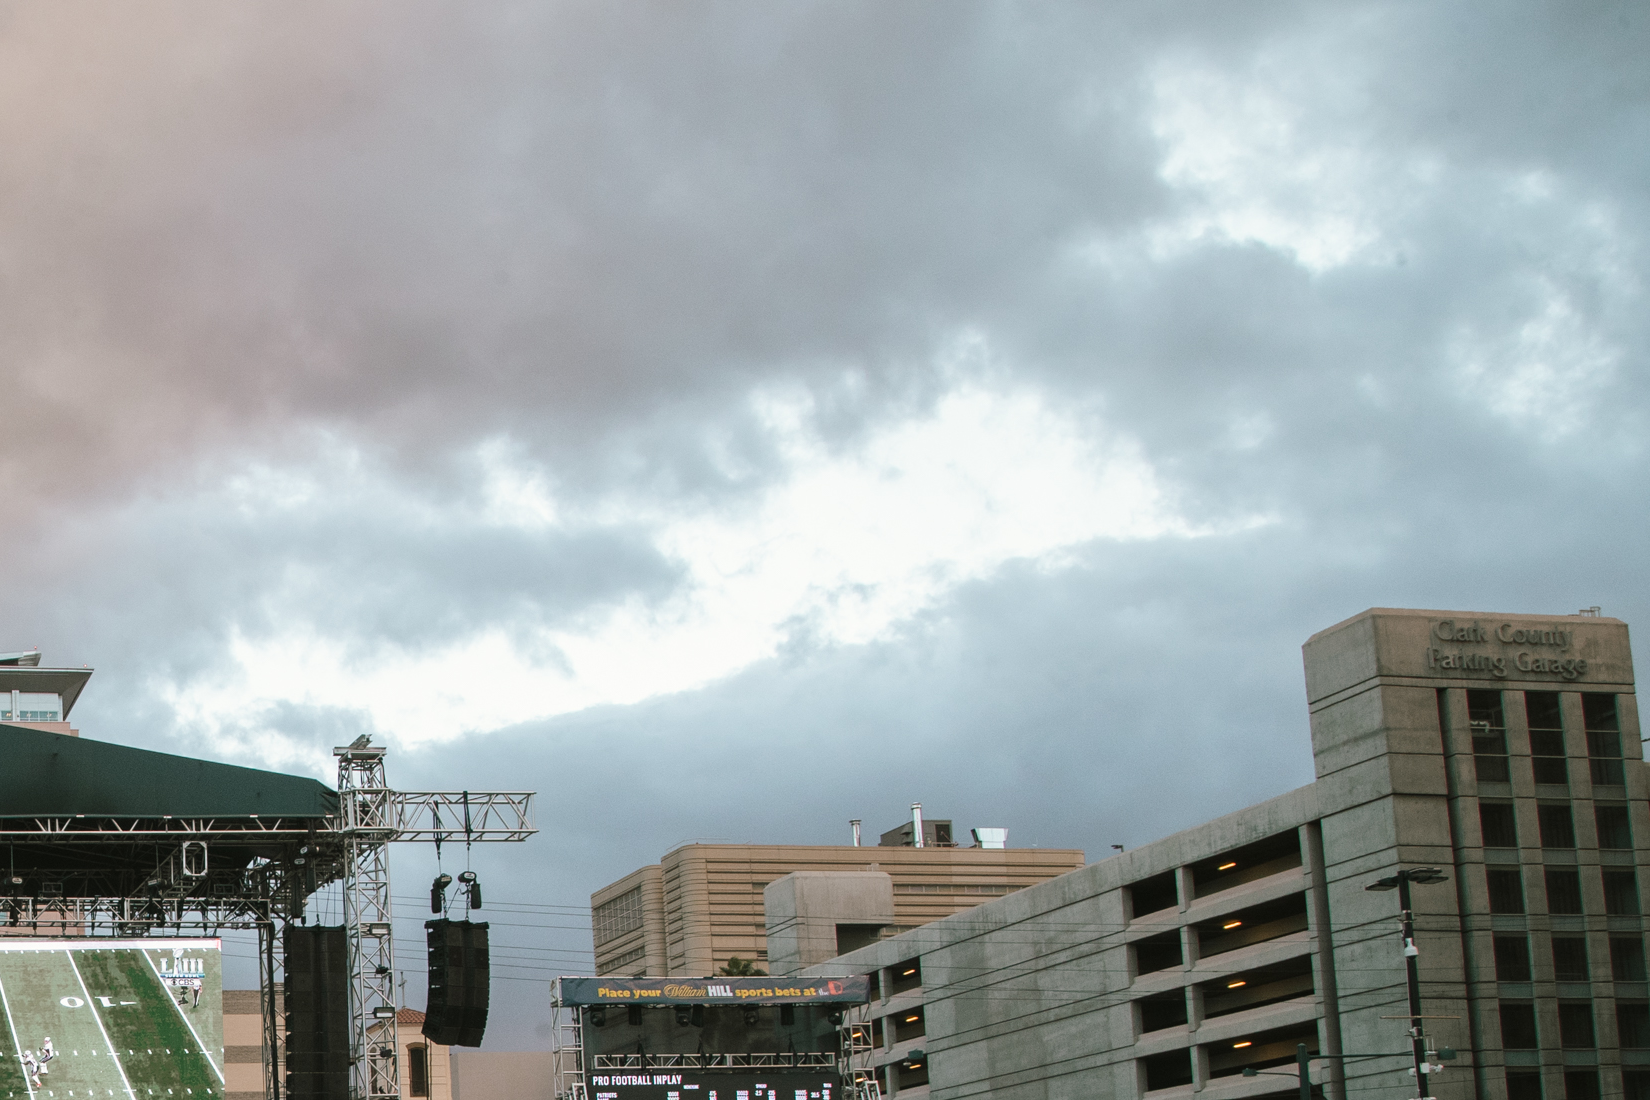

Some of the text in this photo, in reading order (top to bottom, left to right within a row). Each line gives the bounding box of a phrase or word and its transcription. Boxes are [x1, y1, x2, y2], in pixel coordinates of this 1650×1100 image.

[1432, 620, 1573, 649] Clark County
[1427, 648, 1588, 680] Parking Garage
[598, 987, 630, 998] Place
[633, 989, 662, 999] your
[663, 984, 707, 998] William
[708, 985, 733, 997] HILL
[735, 986, 773, 998] sports
[775, 986, 802, 997] bets
[804, 988, 816, 996] at
[592, 1074, 682, 1086] PRO FOOTBALL INPLAY
